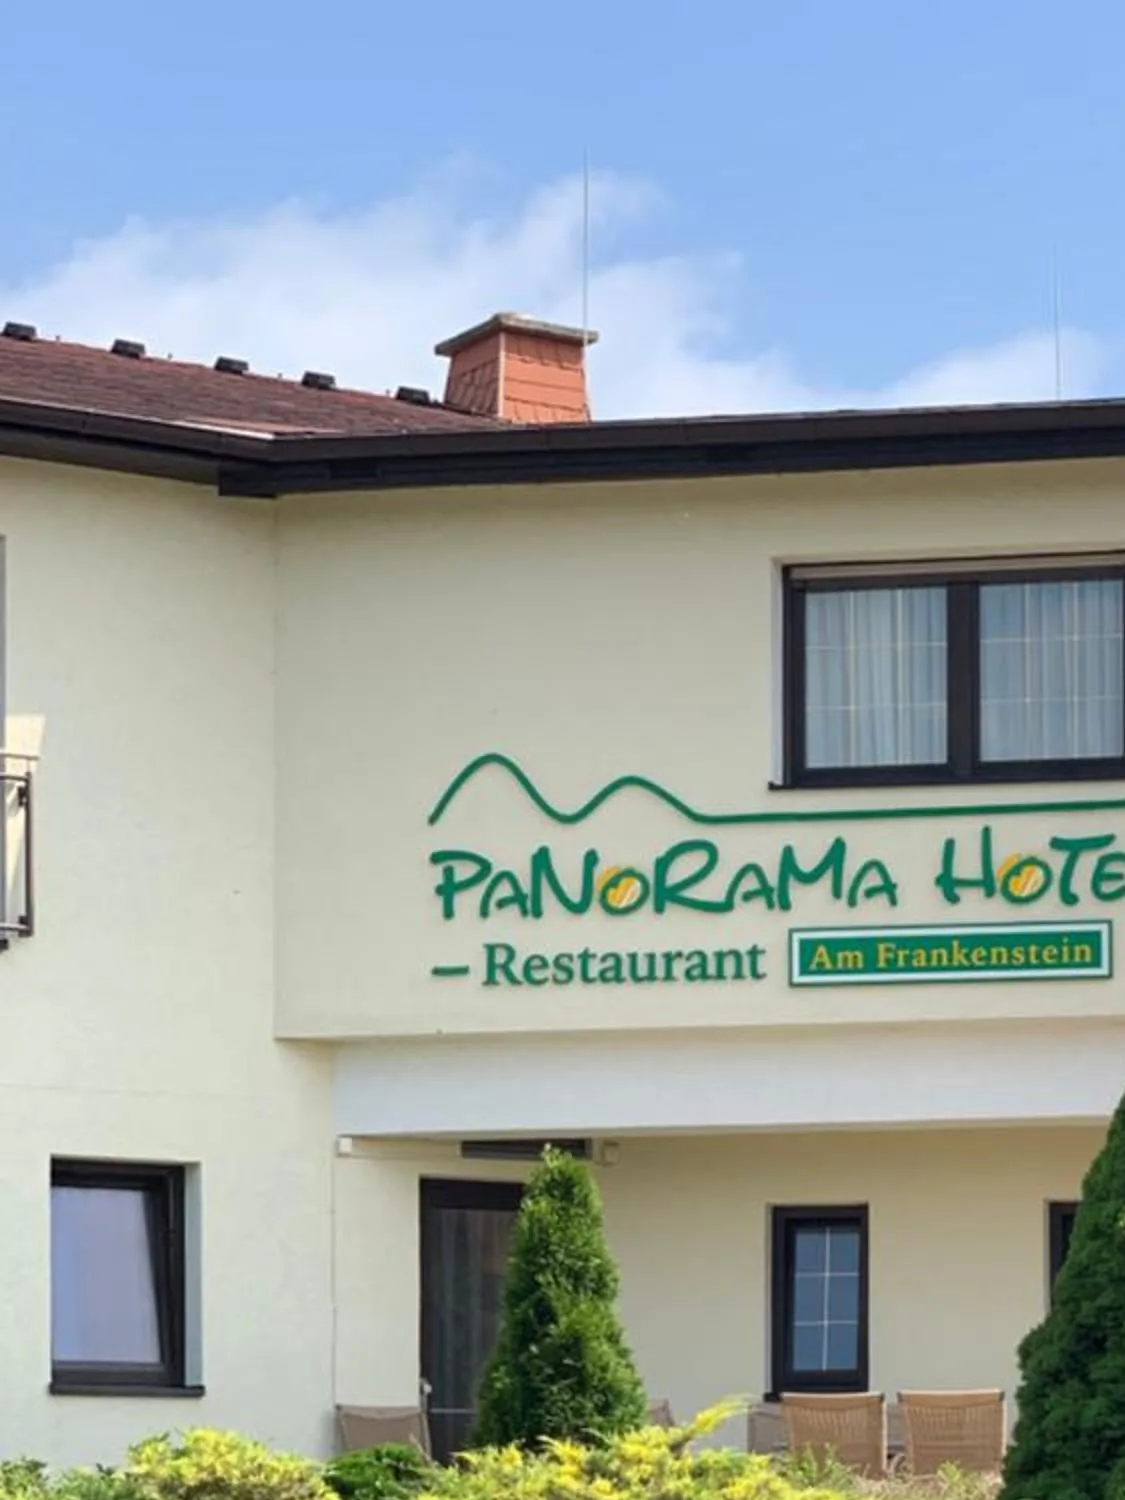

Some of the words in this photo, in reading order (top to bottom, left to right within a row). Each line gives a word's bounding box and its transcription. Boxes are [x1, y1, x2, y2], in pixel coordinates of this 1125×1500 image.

[430, 836, 898, 920] PANORAMA
[481, 942, 768, 987] Restaurant
[808, 944, 865, 971] Am
[876, 937, 1094, 970] Frankenstein
